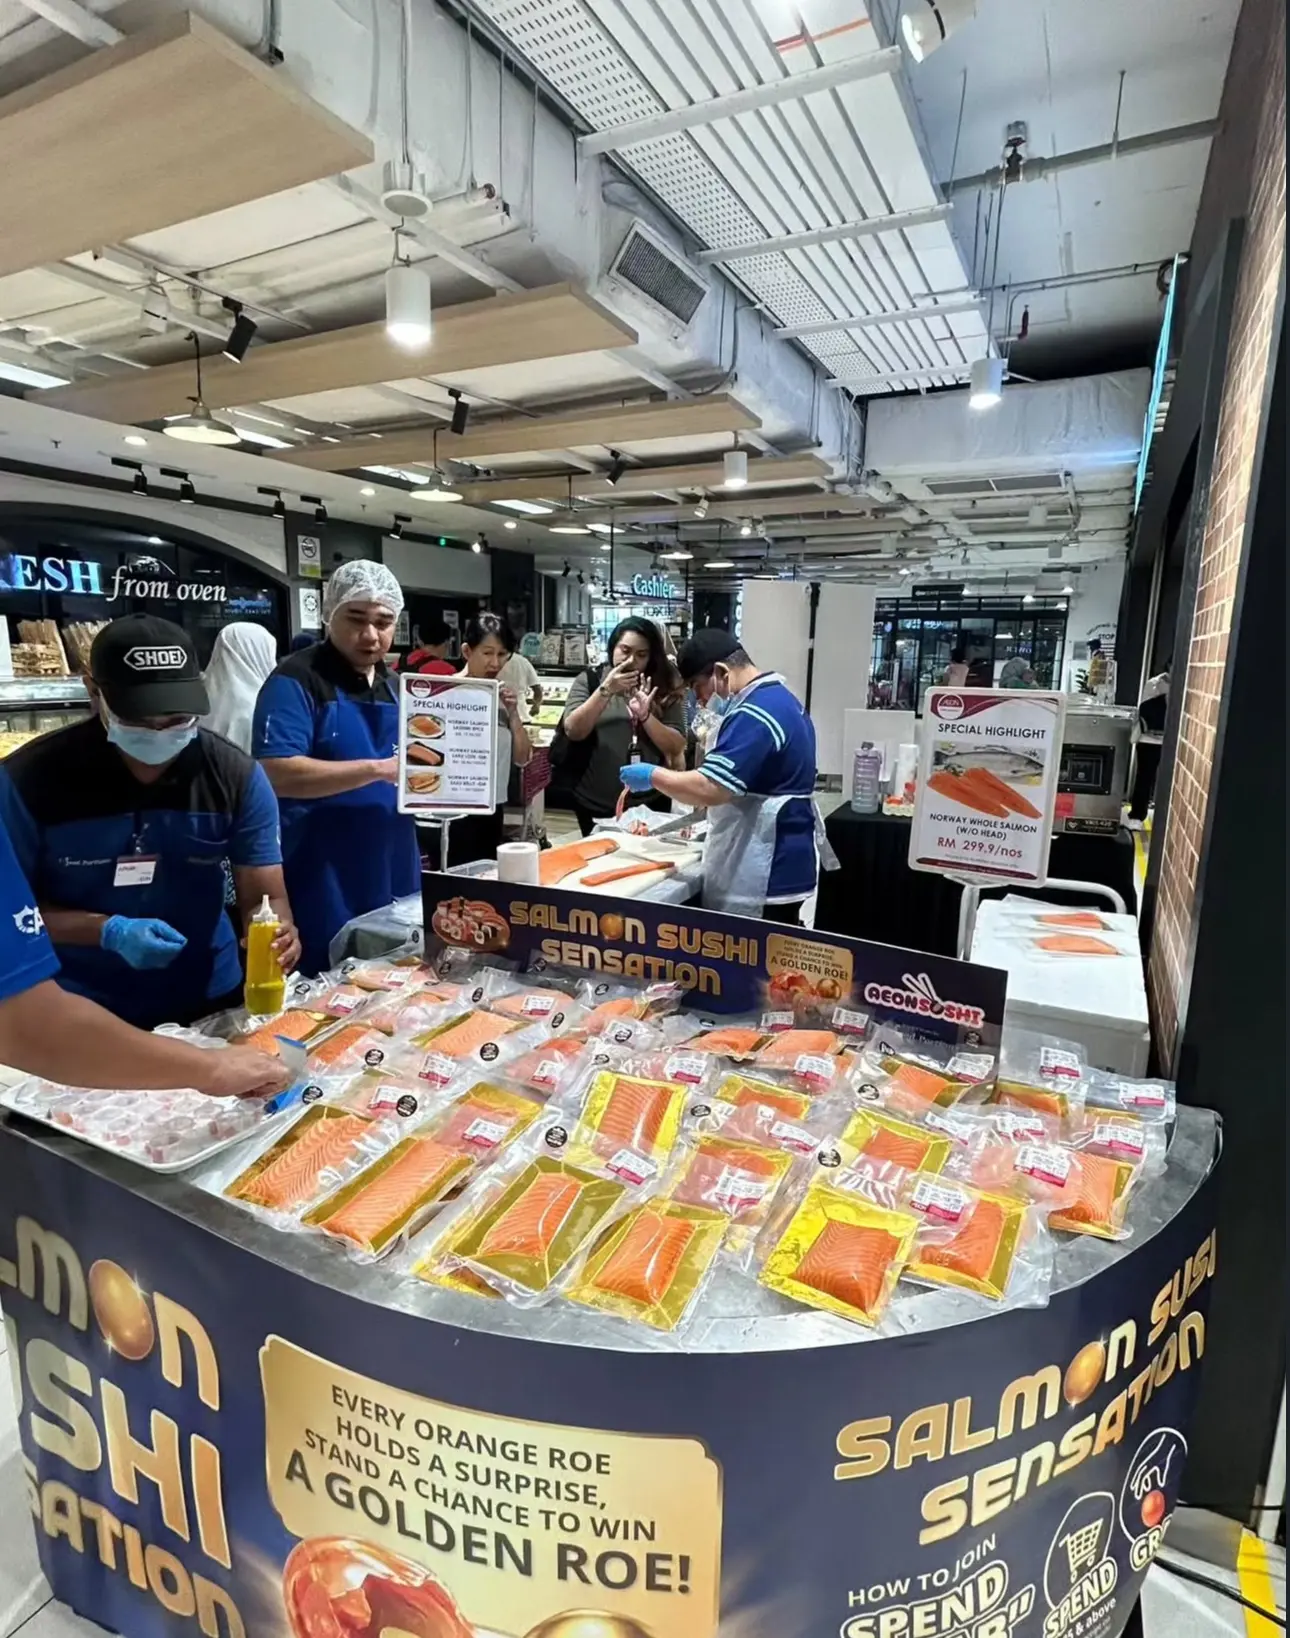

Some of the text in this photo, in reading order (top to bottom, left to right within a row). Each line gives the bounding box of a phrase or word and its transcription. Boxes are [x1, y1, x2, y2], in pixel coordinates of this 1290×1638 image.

[0, 554, 227, 601] ESH from oven
[634, 574, 675, 598] Cashier
[413, 700, 488, 712] SPECIAL HIGHLIGHT
[938, 723, 1046, 739] SPECIAL HIGHLIGHT
[930, 813, 1037, 833] NORWAY WHOLE SALMON
[937, 837, 1022, 859] RM 299.9/nos
[956, 827, 1006, 841] (W/O HEAD)
[510, 901, 757, 966] SALMON SUSHI
[541, 938, 721, 995] SENSATION
[771, 956, 848, 980] A GOLDEN ROE!
[0, 1214, 220, 1411] MON
[331, 1384, 611, 1475] EVERY ORANGE ROE
[834, 1318, 1137, 1480] SALMON
[919, 1311, 1205, 1545] SENSATION
[10, 1310, 231, 1569] SHI
[336, 1416, 607, 1510] HOLDS A SURPRISE,
[305, 1428, 656, 1541] STAND A CHANCE TO WIN
[285, 1448, 691, 1594] A GOLDEN ROE!
[847, 1565, 1006, 1638] SPEND
[848, 1533, 996, 1607] HOW TO JOIN
[1046, 1559, 1116, 1638] SPEND
[1086, 1597, 1117, 1628] above
